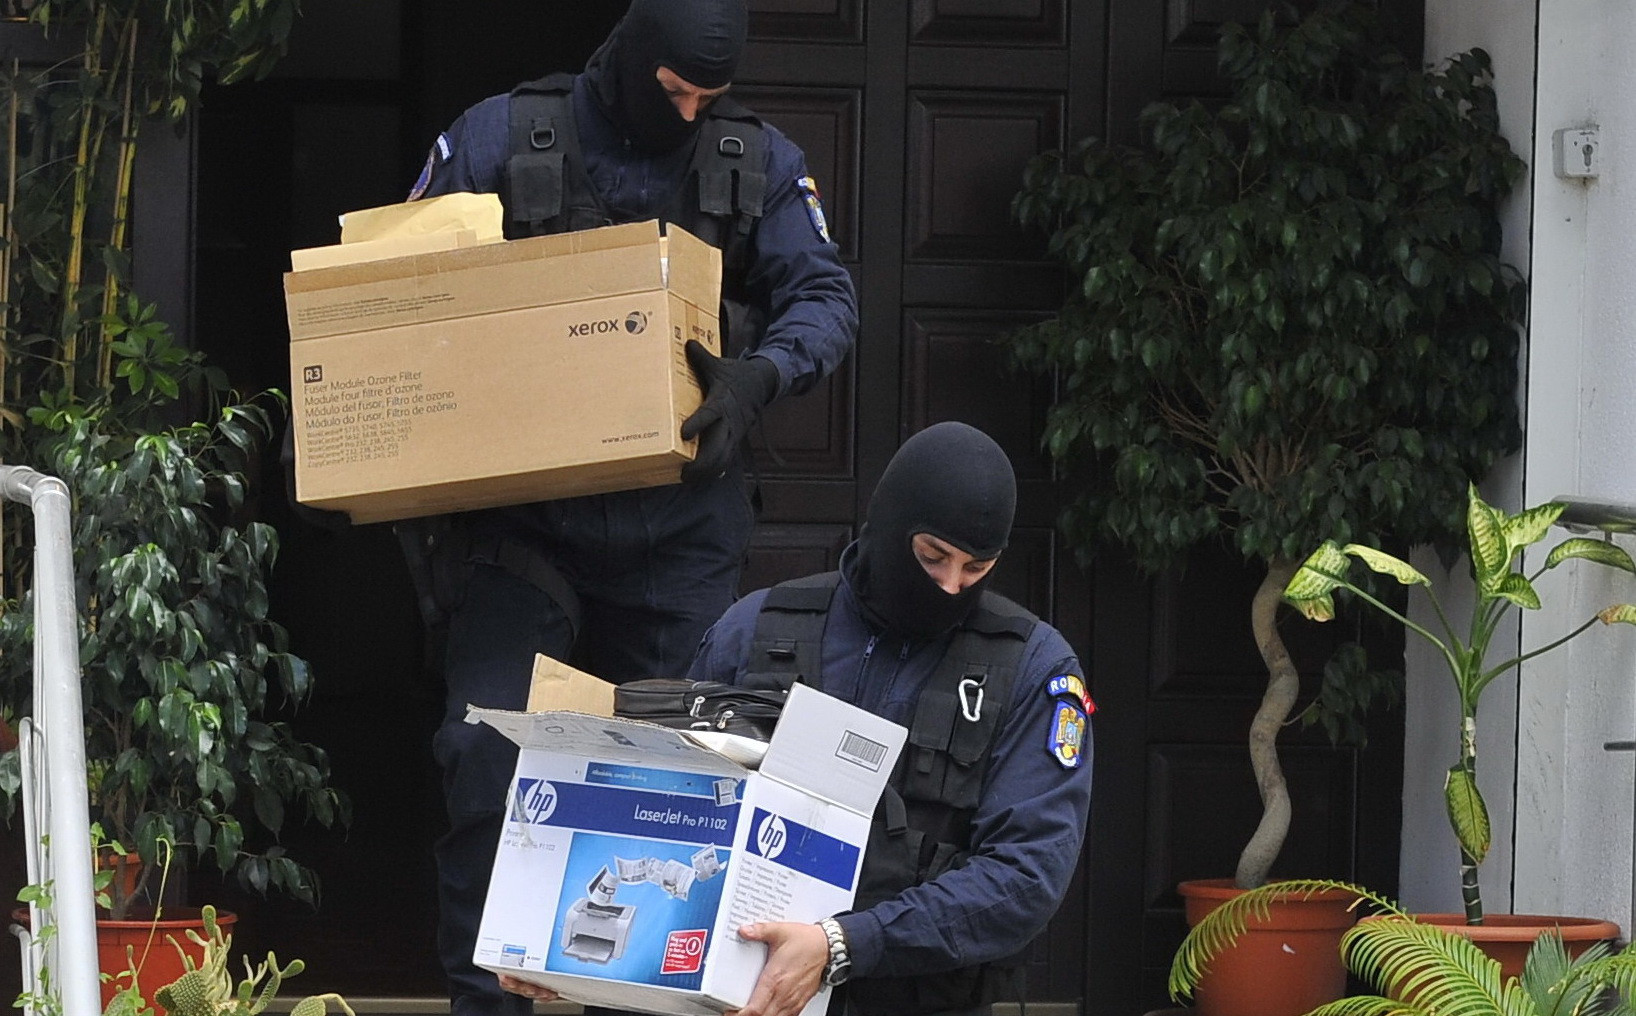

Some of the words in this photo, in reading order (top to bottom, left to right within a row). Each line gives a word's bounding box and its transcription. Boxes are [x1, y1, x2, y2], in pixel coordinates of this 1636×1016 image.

[568, 318, 619, 338] xerox
[304, 384, 328, 394] Fuser
[330, 378, 365, 391] Module
[367, 375, 397, 386] Ozone
[399, 370, 422, 381] Filter
[305, 367, 321, 382] R3
[304, 393, 339, 406] Module
[341, 391, 360, 401] four
[362, 387, 383, 399] filtre
[305, 404, 340, 417] Módulo
[342, 402, 356, 412] del
[386, 395, 410, 407] Filtro
[412, 394, 424, 403] de
[426, 391, 454, 401] ozono
[306, 416, 341, 429] Módulo
[343, 415, 355, 424] do
[386, 407, 410, 418] Filtro
[412, 406, 424, 415] de
[601, 431, 660, 443] www.xerox.com
[526, 780, 556, 824] hp
[634, 803, 681, 824] LaserJet
[682, 815, 697, 827] Pro
[698, 817, 727, 831] P1102
[760, 814, 784, 859] hp
